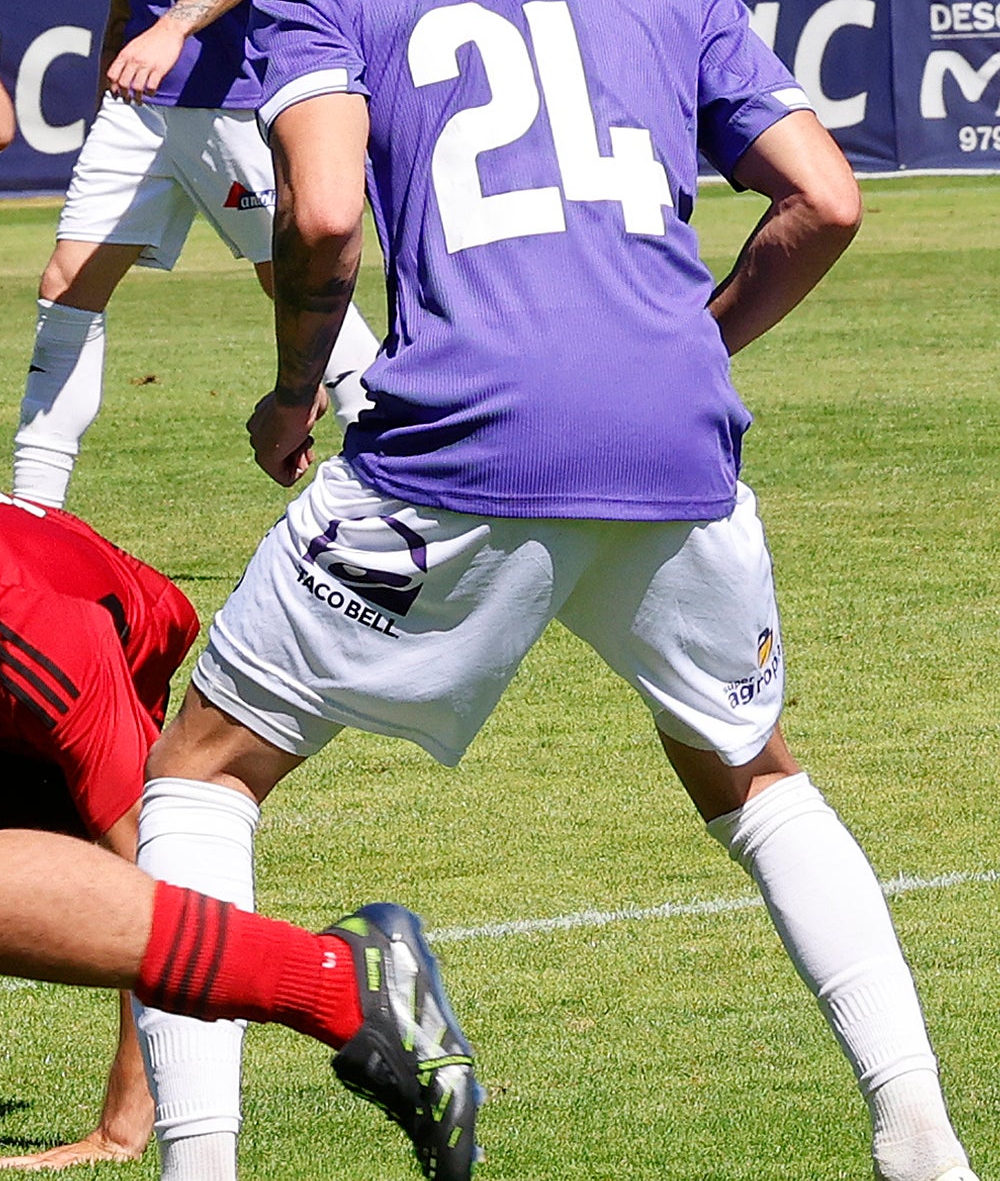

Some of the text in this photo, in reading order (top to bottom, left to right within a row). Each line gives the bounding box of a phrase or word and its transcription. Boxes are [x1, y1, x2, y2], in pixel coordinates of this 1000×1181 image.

[930, 1, 1000, 33] DES
[406, 0, 675, 255] 24
[296, 564, 399, 640] TACO BELL
[727, 644, 781, 710] agrop
